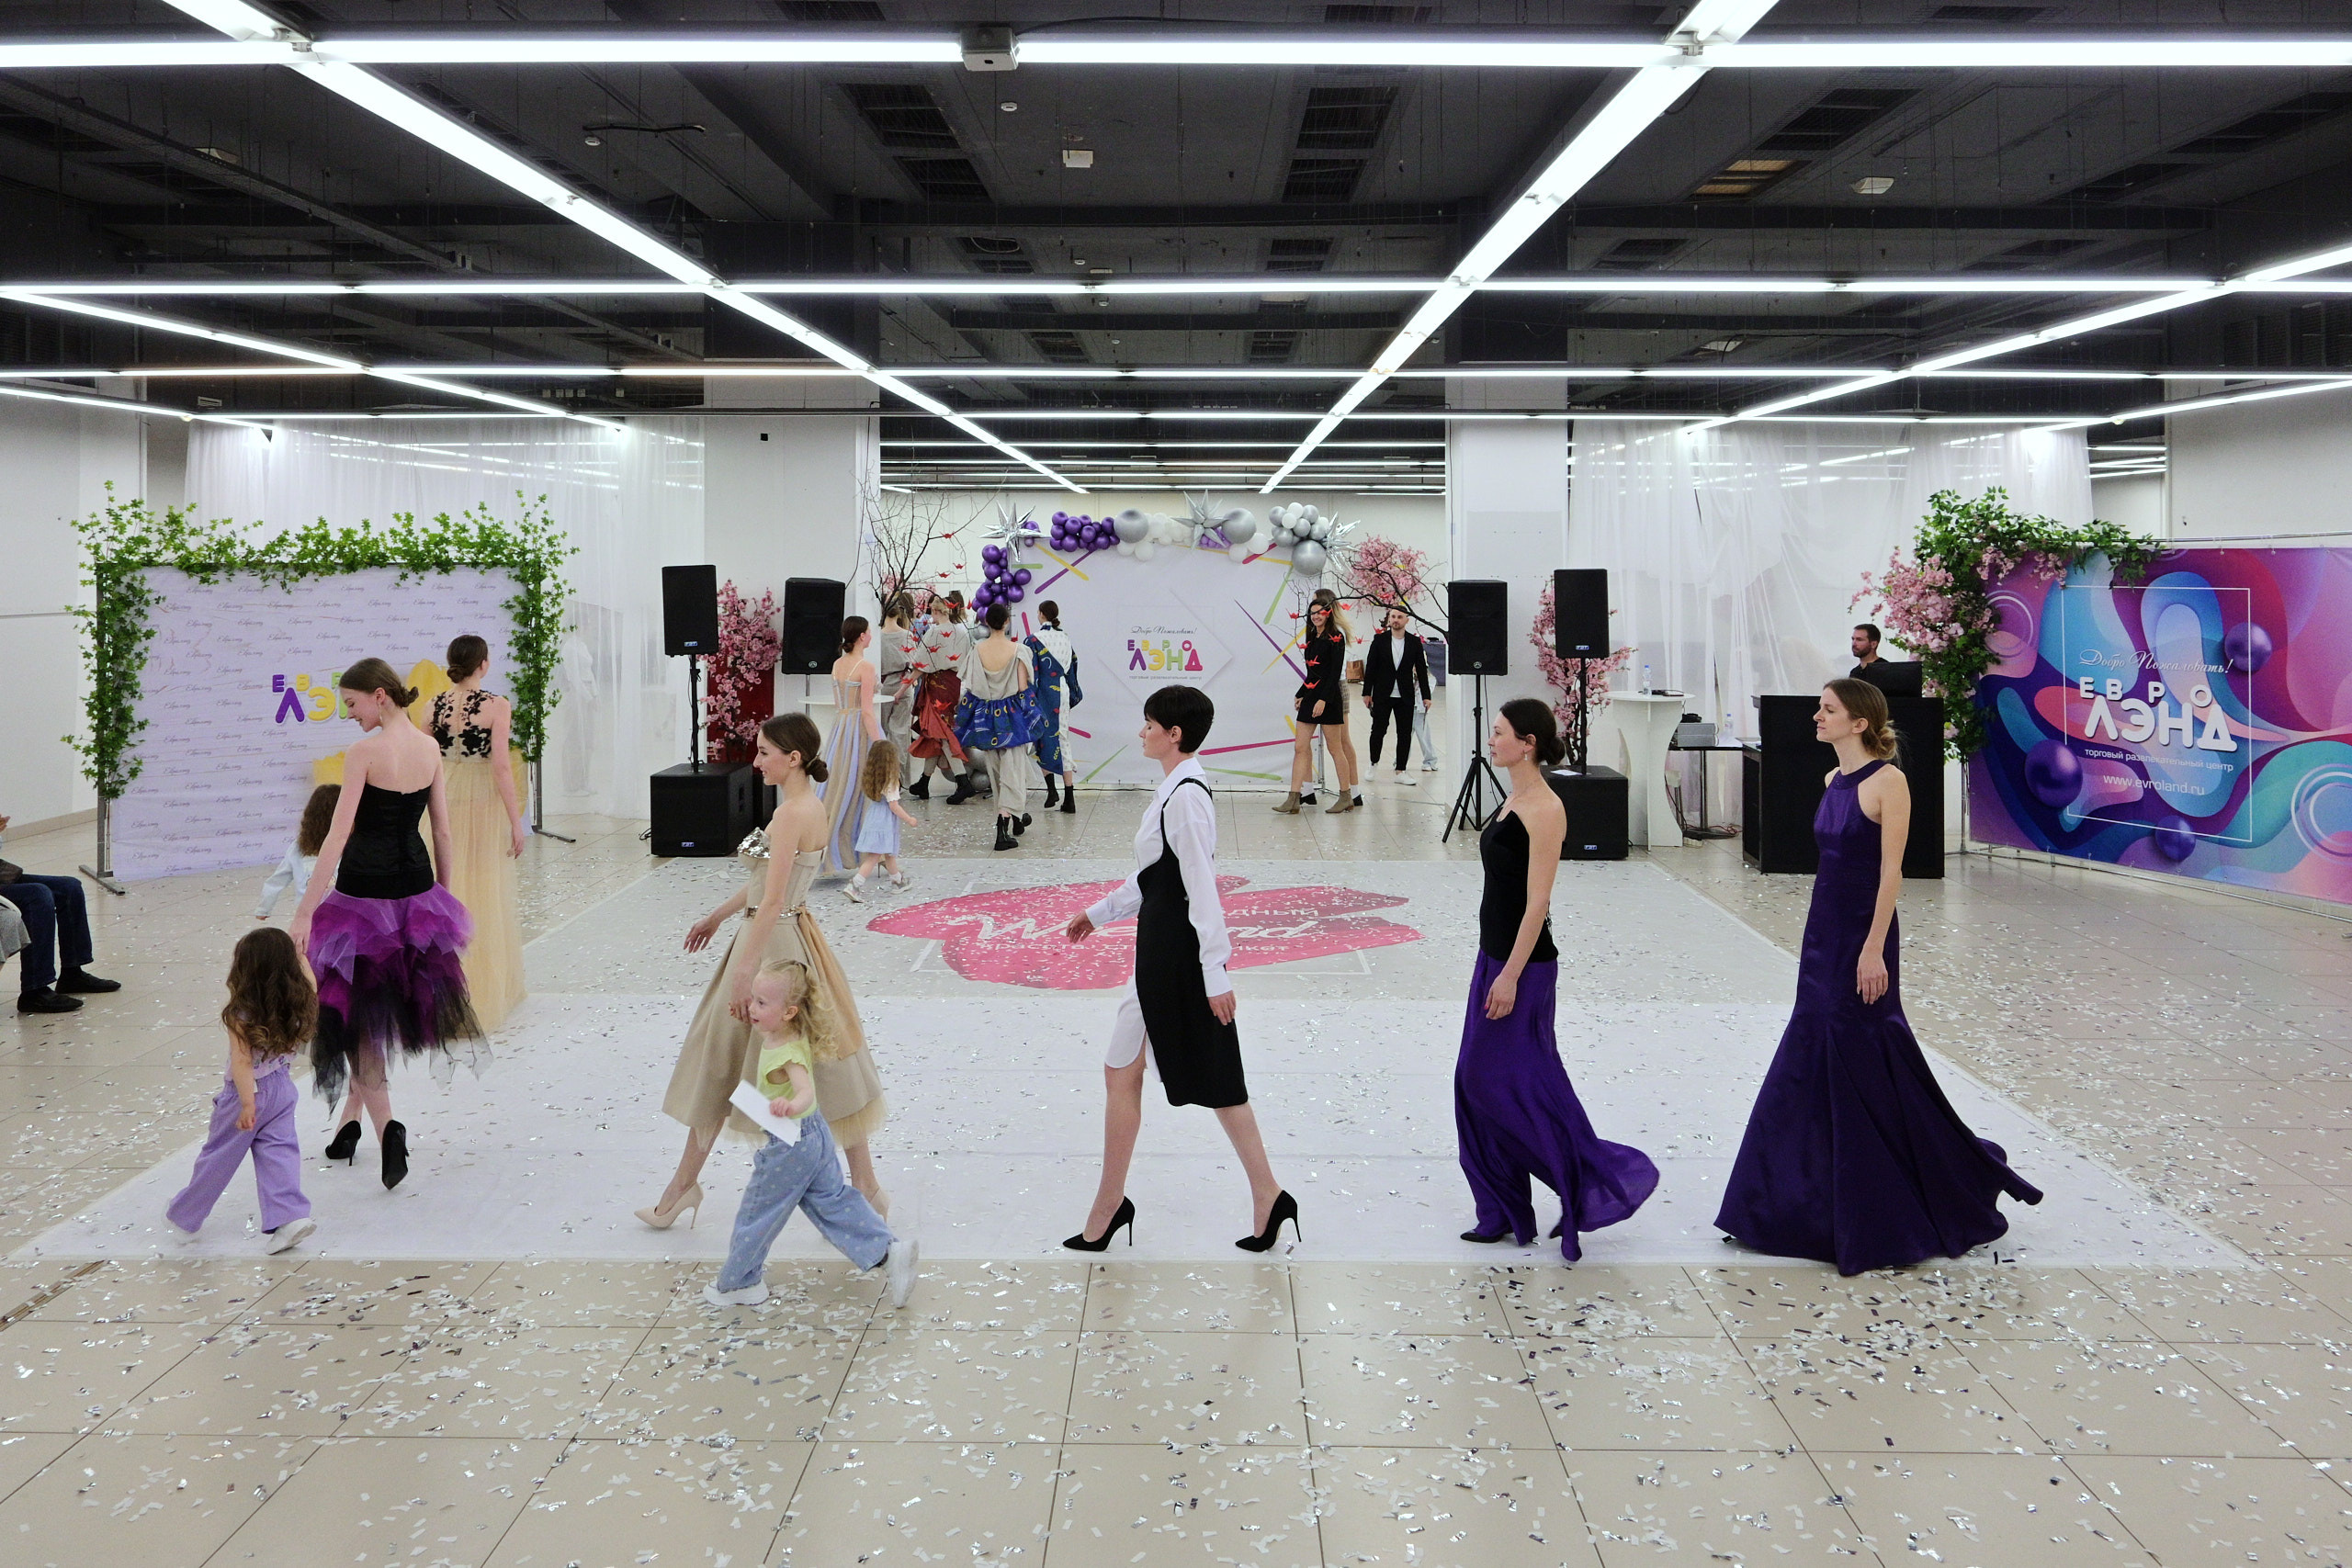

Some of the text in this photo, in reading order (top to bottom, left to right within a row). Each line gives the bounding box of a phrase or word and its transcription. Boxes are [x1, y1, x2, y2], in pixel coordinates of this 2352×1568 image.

[1129, 648, 1204, 671] ЛЭНД
[2079, 649, 2125, 671] Добро
[272, 671, 343, 693] ЕВР
[2079, 676, 2212, 707] ЕВРО
[2085, 694, 2238, 752] ЛЭНД
[2085, 749, 2234, 773] торговый развлекательный центр
[2103, 774, 2205, 795] www.evroland.ru
